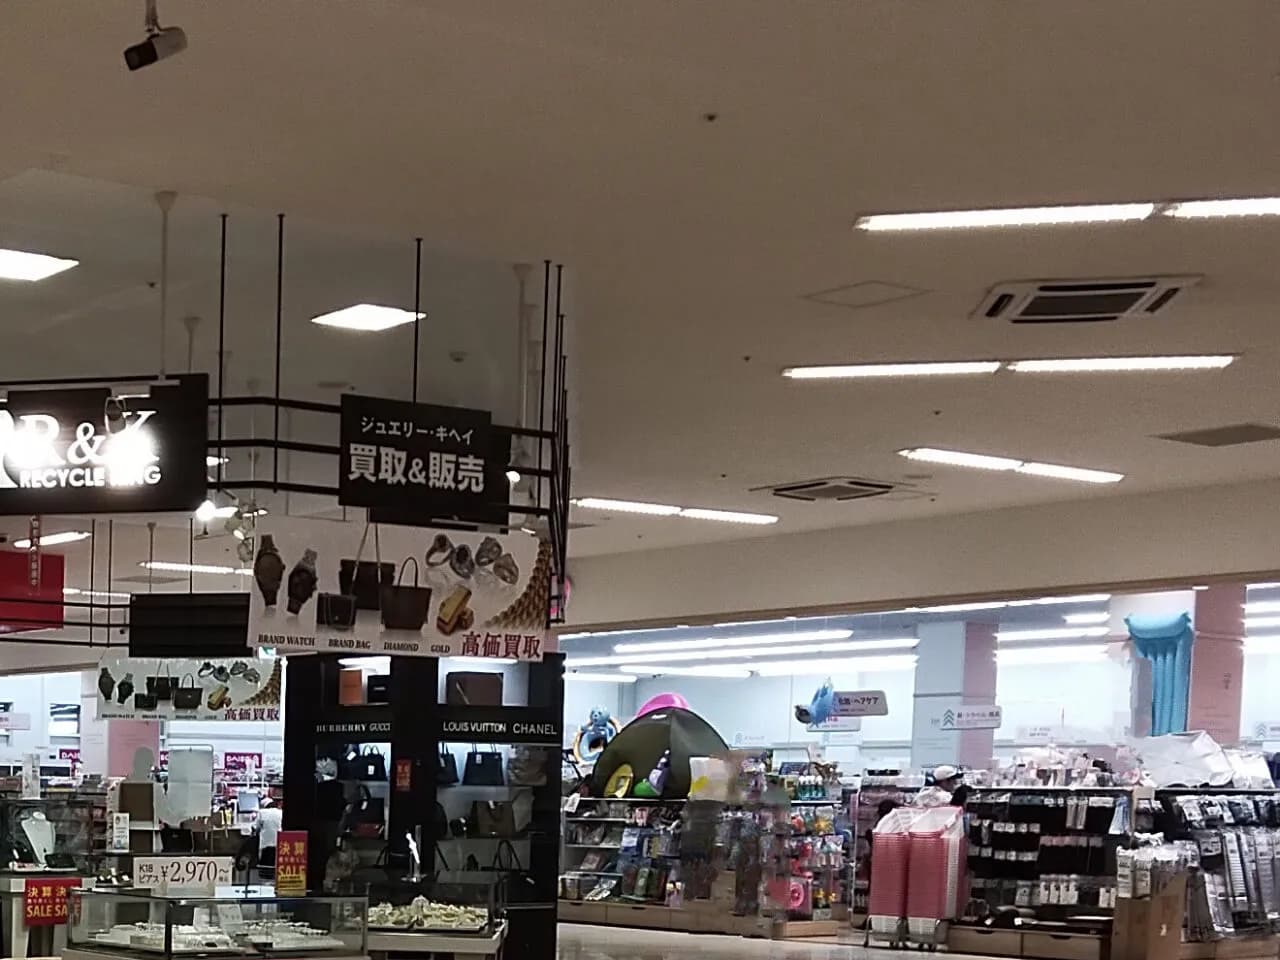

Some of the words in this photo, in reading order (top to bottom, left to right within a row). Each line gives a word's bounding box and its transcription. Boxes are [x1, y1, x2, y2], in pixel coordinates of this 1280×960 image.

[361, 416, 474, 445] ジュエリー・キヘイ
[348, 443, 484, 493] 買取&販売
[20, 467, 105, 488] RECYCLE
[258, 634, 285, 645] BRAND
[287, 636, 315, 647] WATCH
[328, 638, 354, 648] BRAND
[355, 640, 371, 649] BAG
[383, 641, 419, 652] DIAMOND
[461, 631, 541, 658] 高価買取
[443, 722, 469, 732] LOUIS
[470, 723, 507, 733] VUITTON
[512, 723, 557, 735] CHANEL
[139, 863, 153, 872] K18
[278, 865, 305, 877] SALE
[139, 874, 159, 884] ピアス
[26, 905, 53, 918] SALE
[54, 904, 81, 917] SAE
